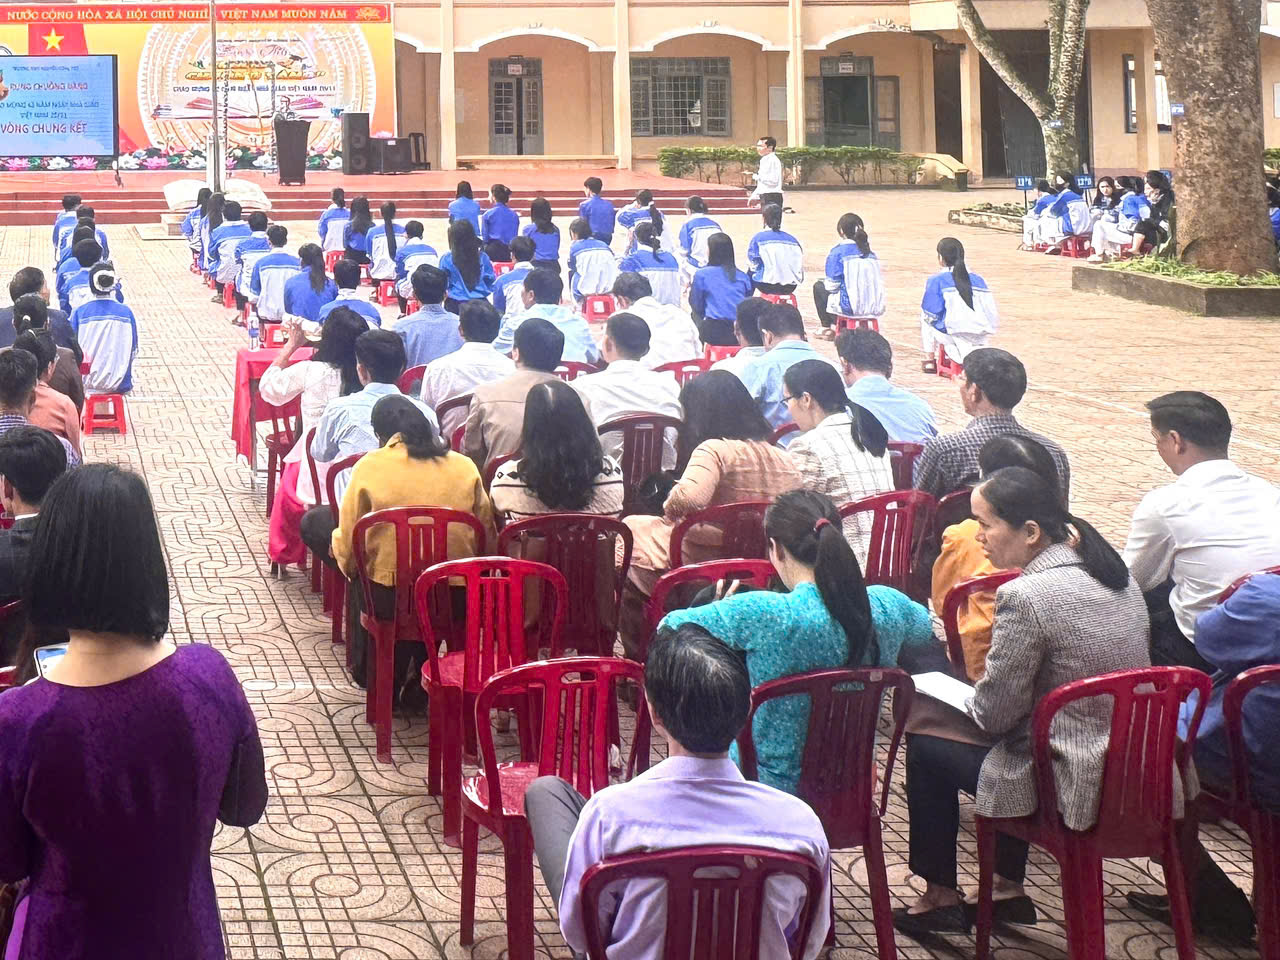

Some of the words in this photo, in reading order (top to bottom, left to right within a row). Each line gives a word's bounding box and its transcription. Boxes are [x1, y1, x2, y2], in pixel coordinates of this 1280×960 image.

[7, 9, 39, 21] NƯỚC
[41, 8, 74, 22] CỘNG
[77, 8, 103, 21] HÒA
[105, 9, 123, 20] XÃ
[125, 9, 148, 21] HỘI
[150, 7, 175, 19] CHỦ
[178, 7, 210, 19] NGHĨ
[220, 8, 248, 20] VIỆT
[251, 9, 278, 19] NAM
[281, 7, 317, 19] MUÔN
[323, 7, 347, 19] NĂM
[0, 122, 29, 134] VÒNG
[31, 123, 67, 134] CHUNG
[70, 120, 88, 134] KẾT
